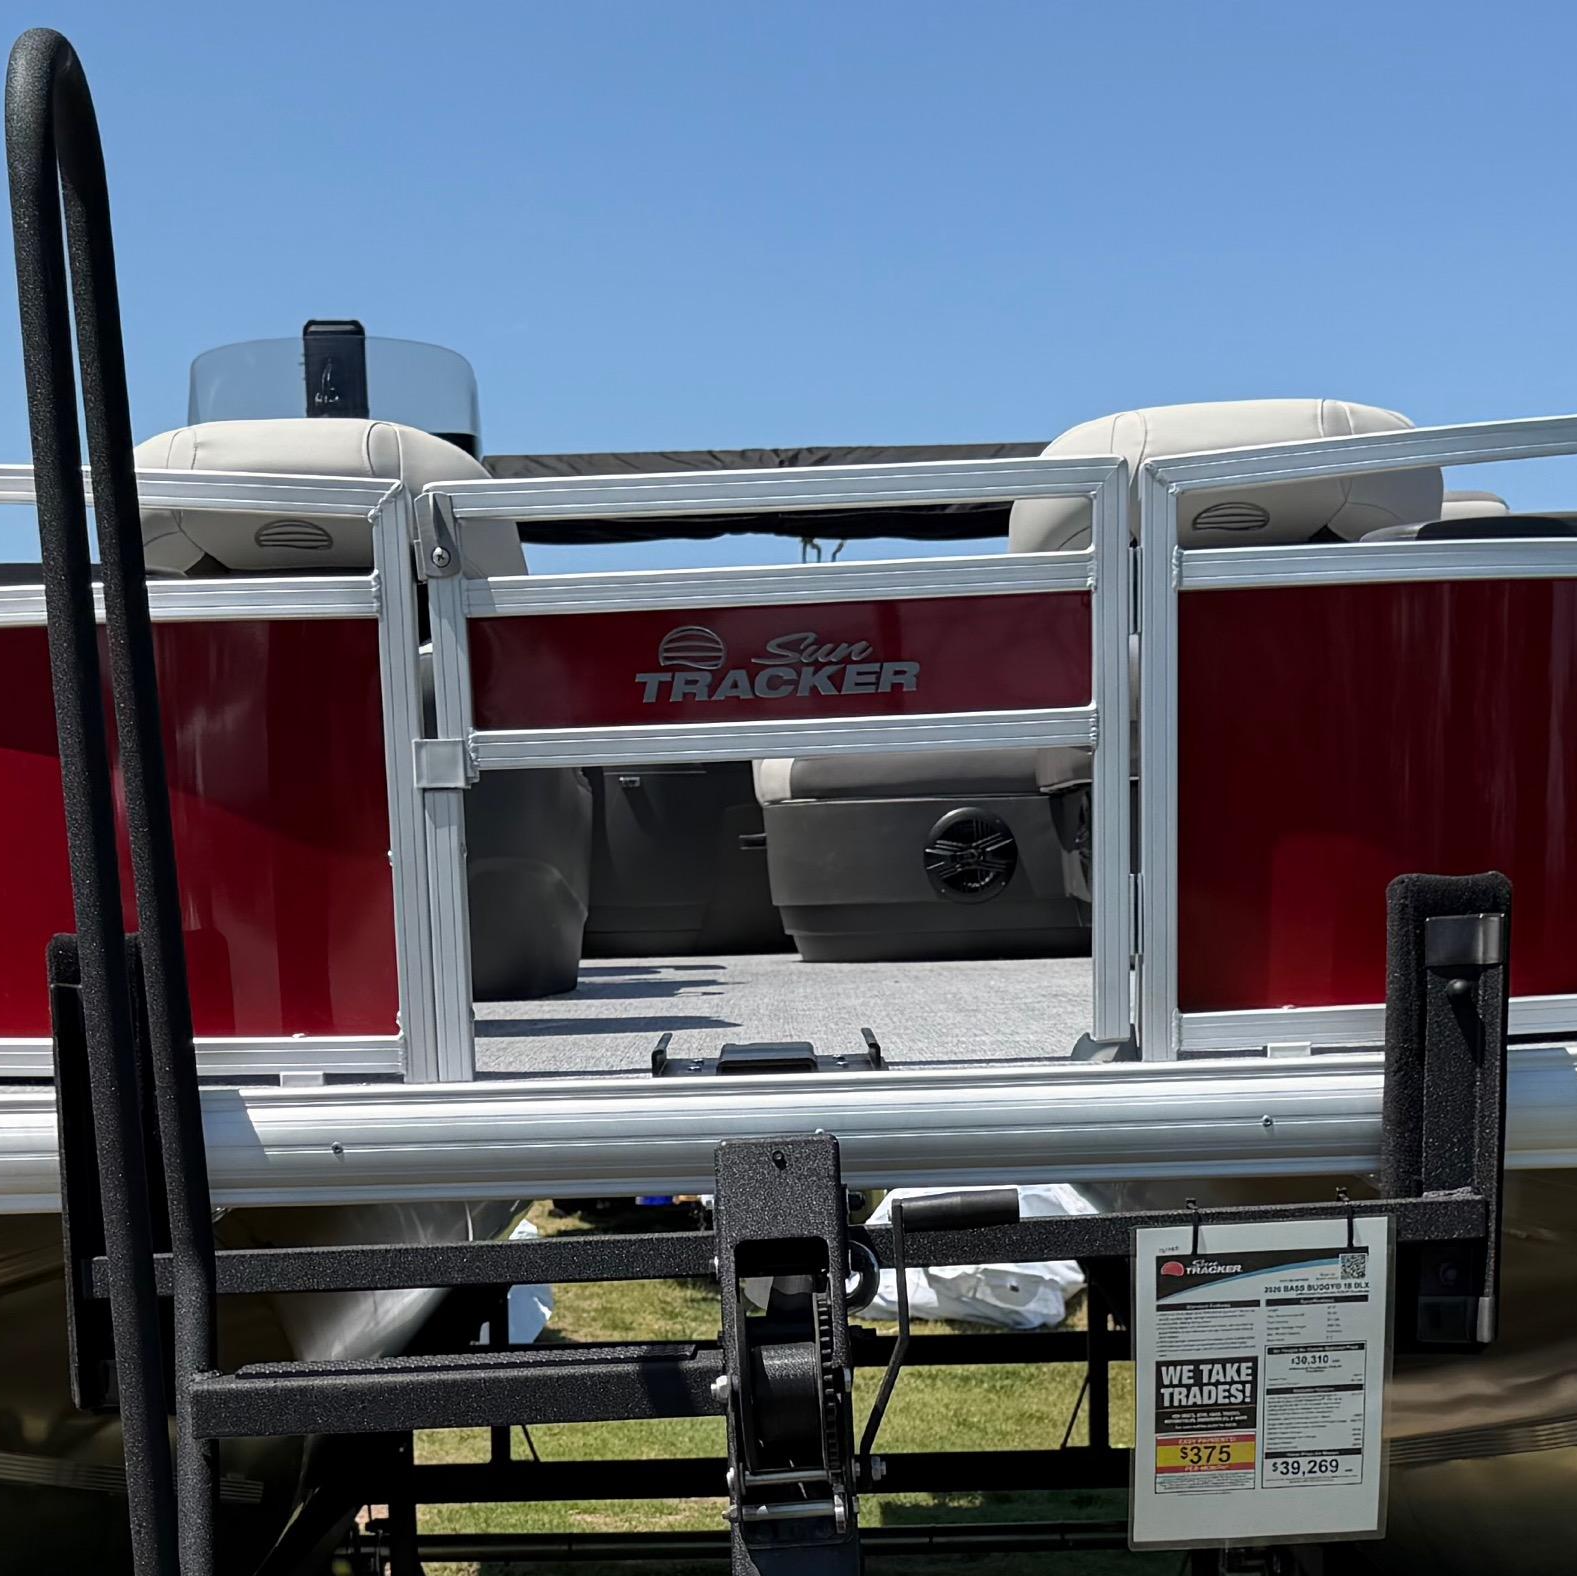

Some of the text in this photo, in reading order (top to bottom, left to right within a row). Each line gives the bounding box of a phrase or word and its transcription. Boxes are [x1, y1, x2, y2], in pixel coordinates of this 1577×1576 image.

[751, 632, 873, 665] Sun
[635, 661, 921, 704] TRACKER
[1186, 1264, 1242, 1275] TRACKER
[1161, 1364, 1195, 1385] WE
[1199, 1362, 1253, 1383] TAKE
[1160, 1383, 1252, 1407] TRADES!
[1180, 1444, 1231, 1464] $375
[1272, 1458, 1340, 1477] $39,269
